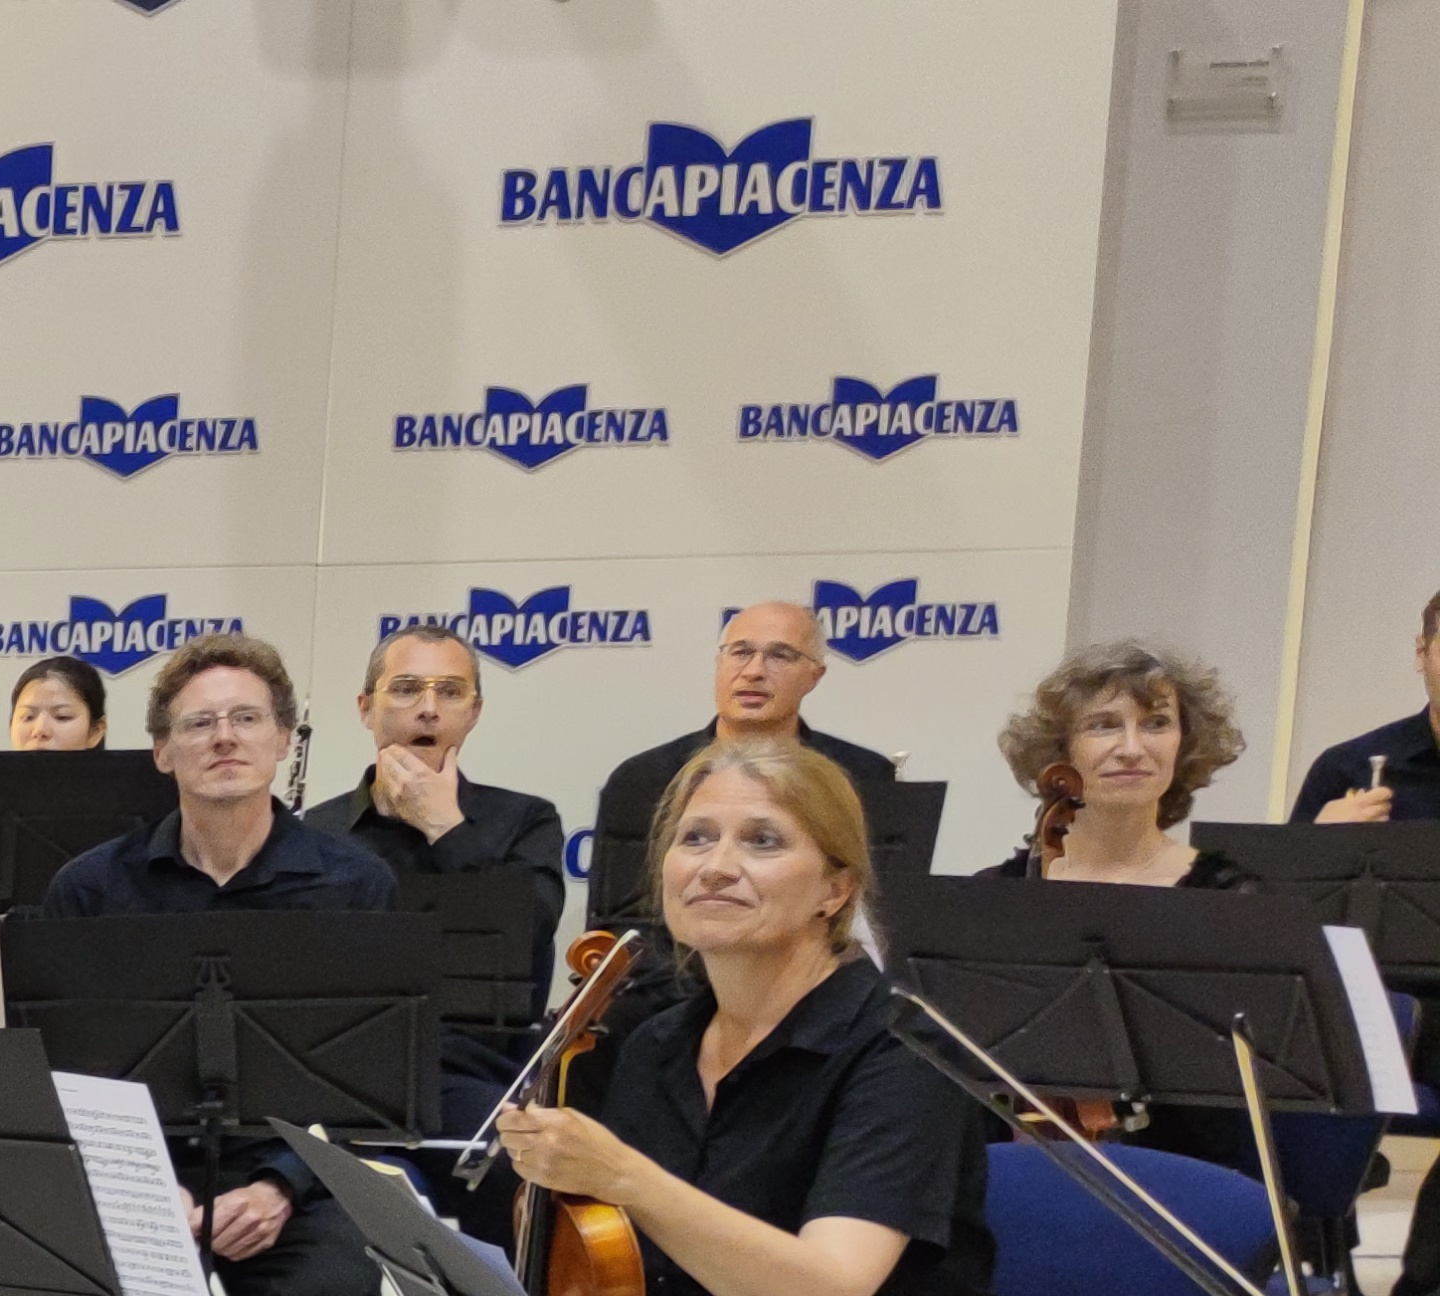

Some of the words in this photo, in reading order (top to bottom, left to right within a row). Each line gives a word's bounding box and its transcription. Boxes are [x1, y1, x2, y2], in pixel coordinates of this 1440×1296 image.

[501, 157, 942, 221] BANCAPIACENZA
[394, 409, 668, 447] BANCAPIACENZA
[740, 401, 1017, 437] BANCAPIACENZA
